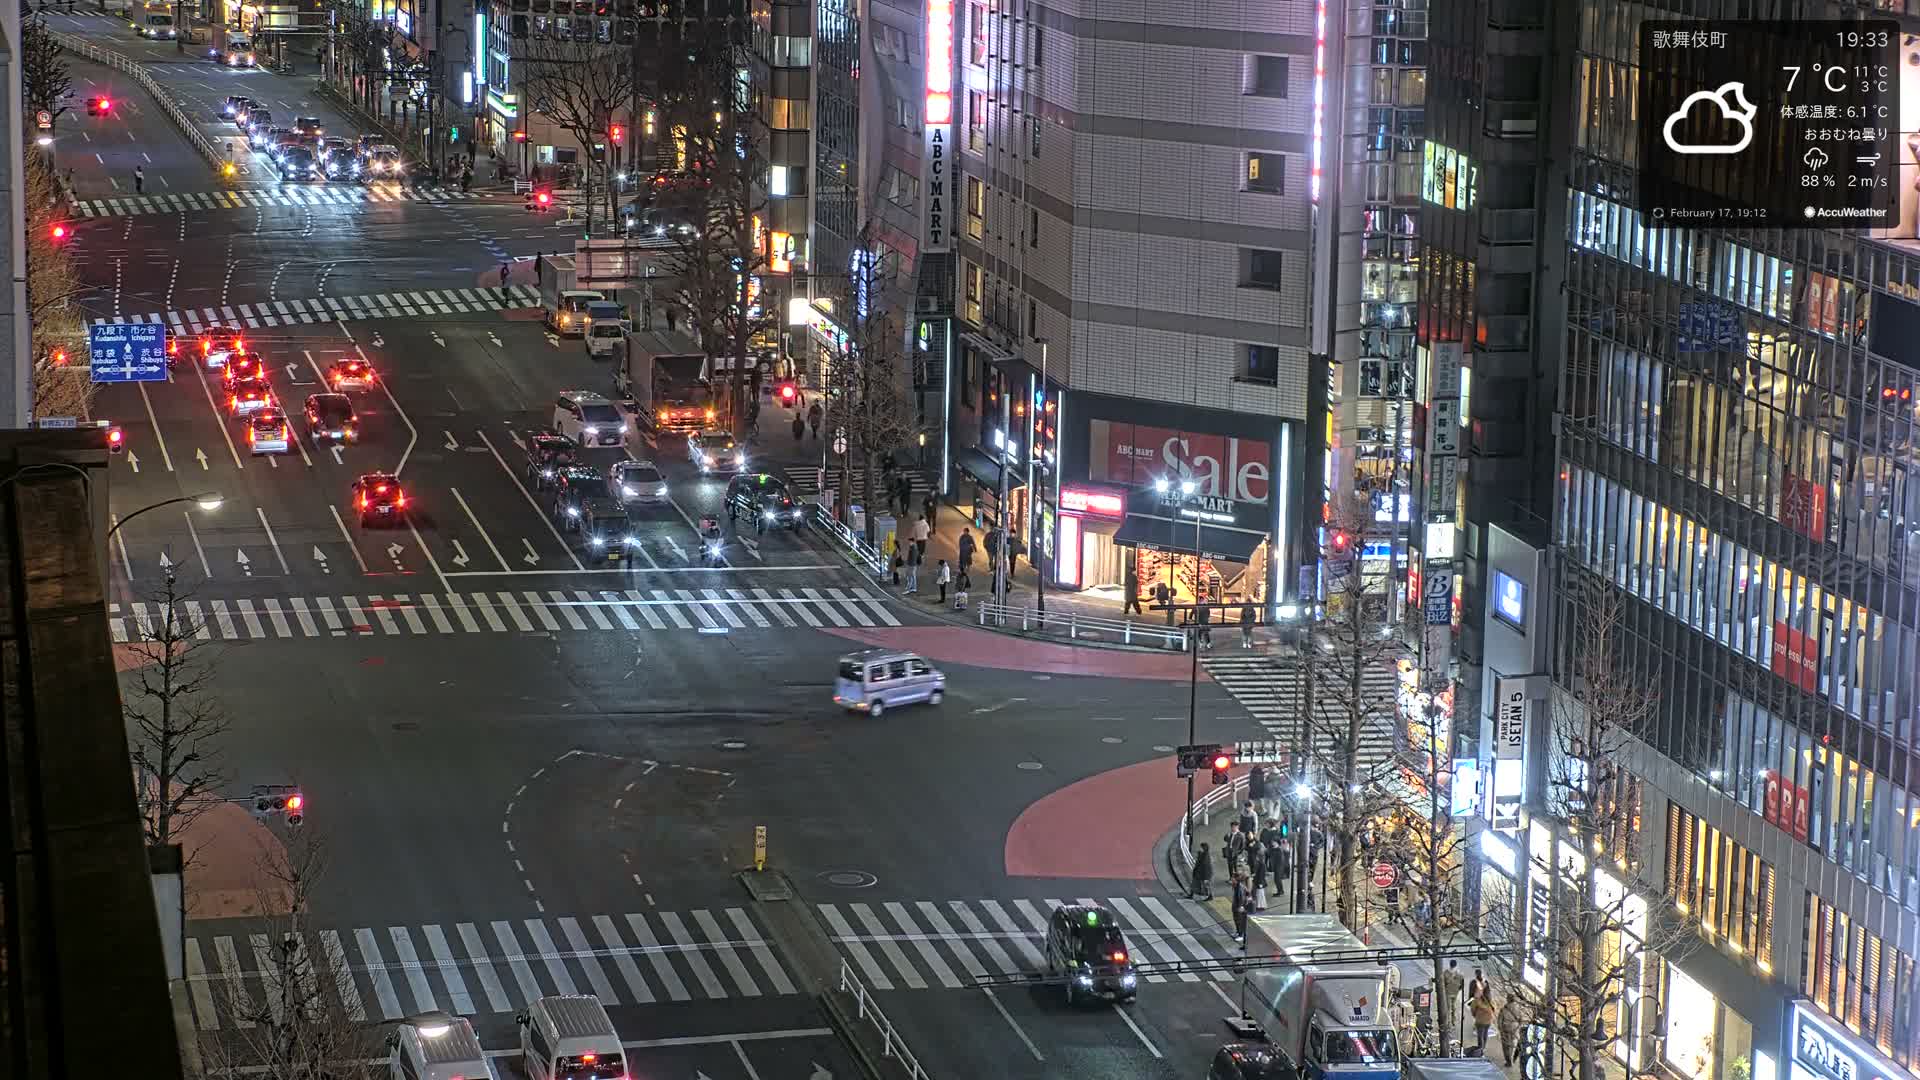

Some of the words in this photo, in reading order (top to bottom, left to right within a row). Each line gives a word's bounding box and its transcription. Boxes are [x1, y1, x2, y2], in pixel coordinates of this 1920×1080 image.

[97, 326, 125, 335] 九段下
[94, 349, 116, 358] 池袋
[141, 347, 163, 357] 渋谷
[1117, 443, 1154, 457] ABCMART
[1162, 436, 1269, 505] Sale
[1436, 515, 1447, 523] 7F
[1511, 692, 1524, 702] 5
[1501, 702, 1509, 720] CITY
[1500, 722, 1509, 740] PARK
[1509, 705, 1522, 747] ISETAN
